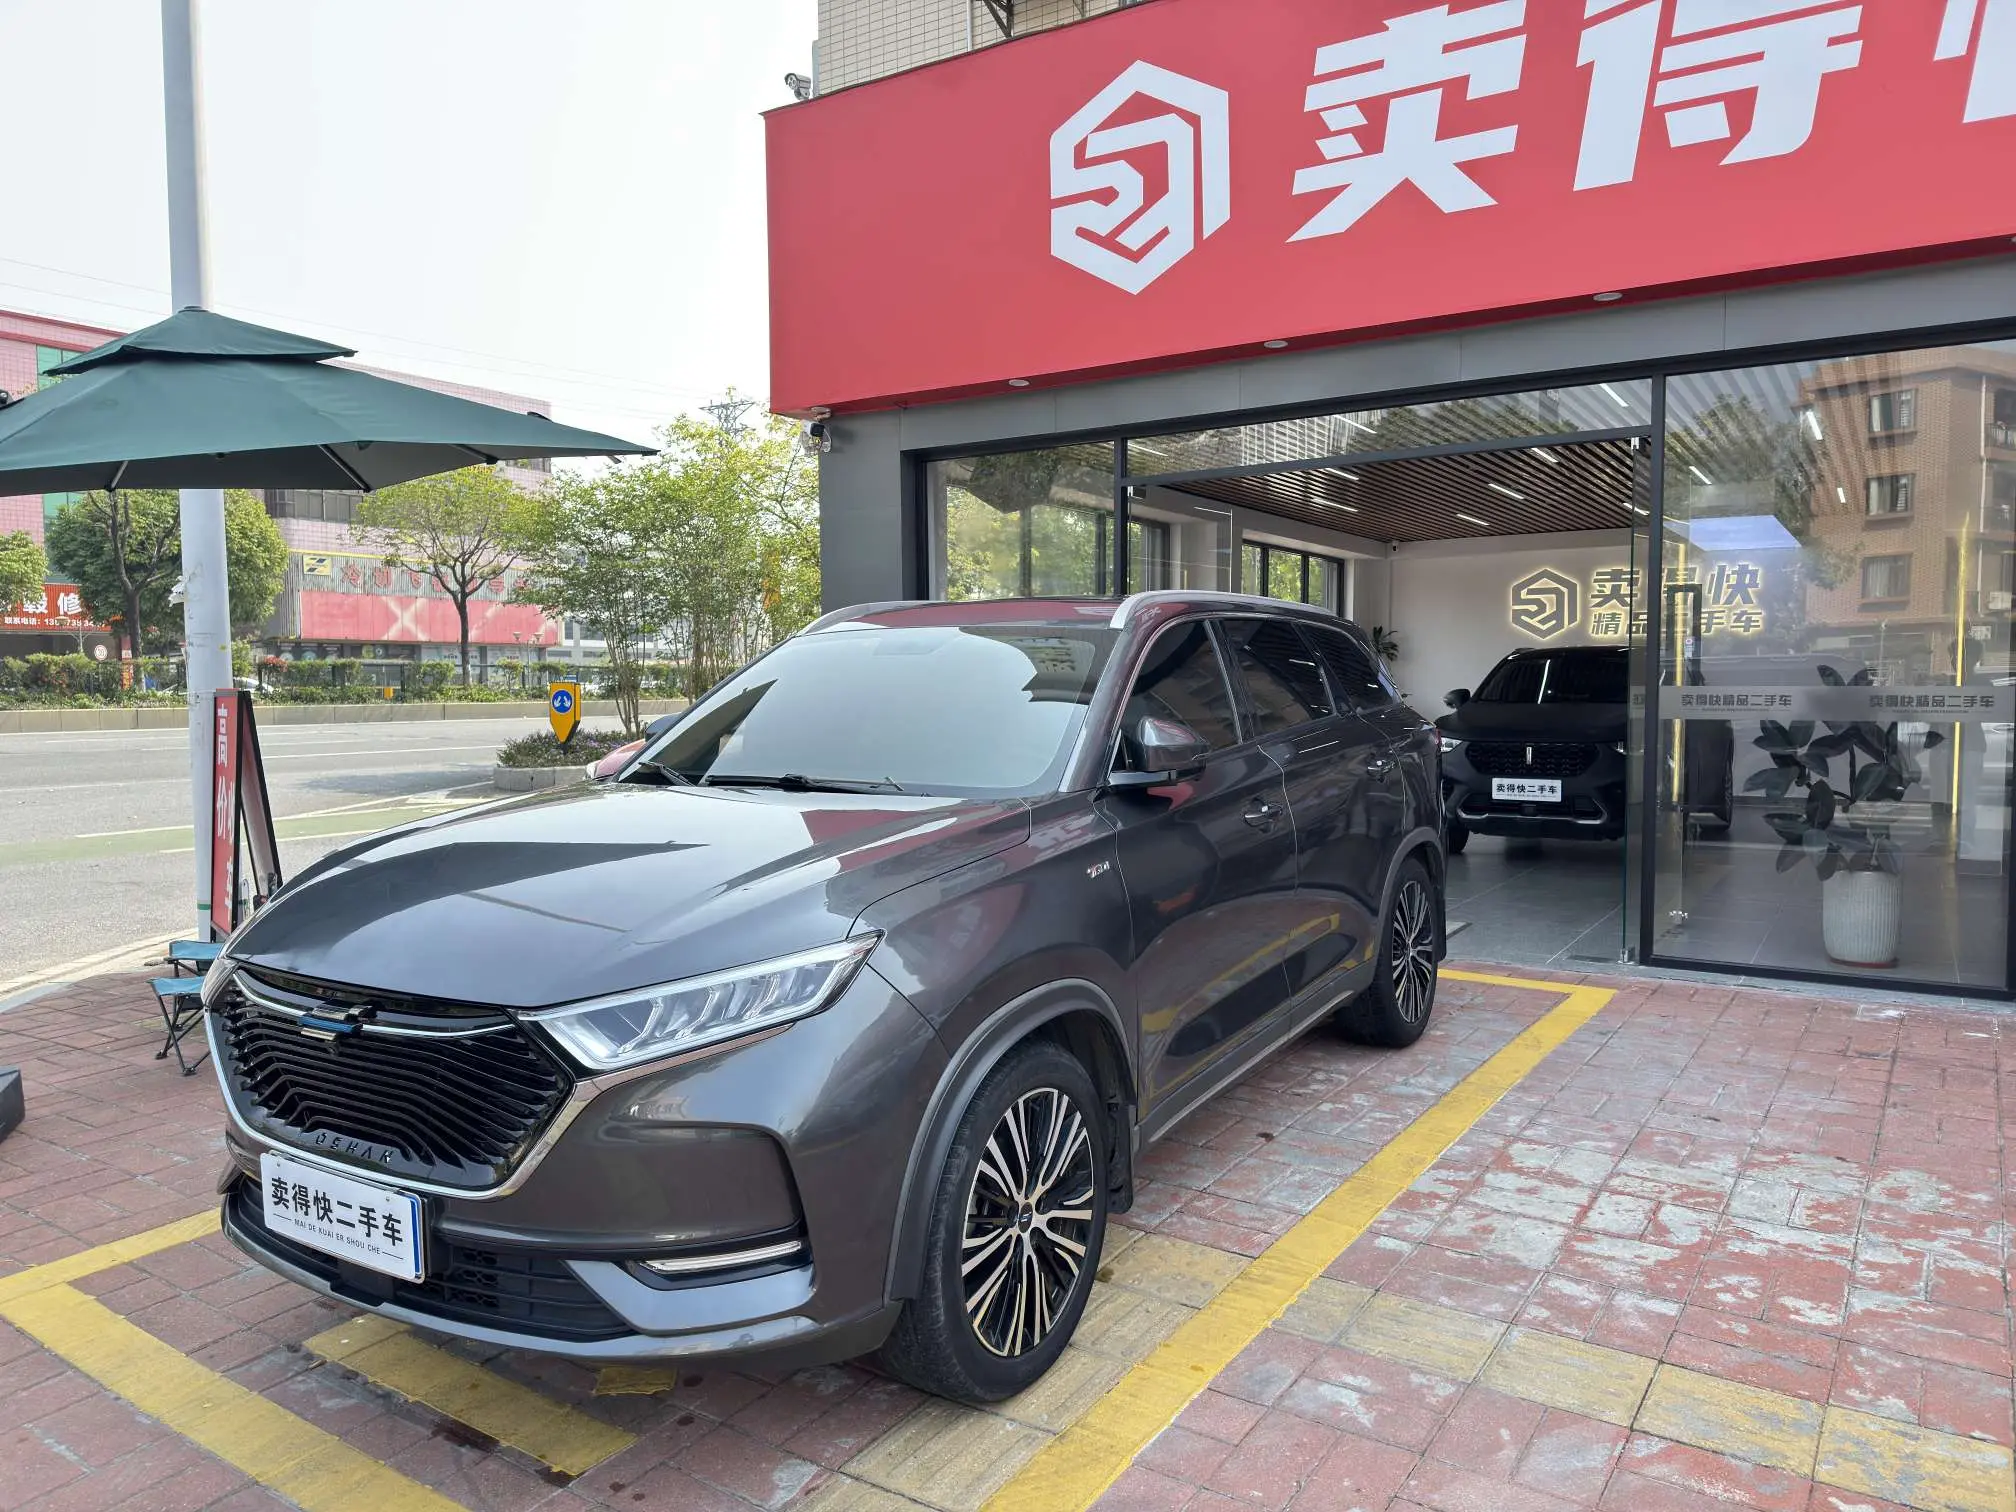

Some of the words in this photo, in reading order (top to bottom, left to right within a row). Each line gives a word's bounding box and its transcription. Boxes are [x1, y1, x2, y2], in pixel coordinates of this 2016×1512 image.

[1681, 694, 1792, 707] 卖得快精品二手车
[1869, 694, 1995, 708] 卖得快精品二手车
[1496, 783, 1558, 795] 卖得快二手车
[315, 1132, 394, 1163] OSHAN
[271, 1176, 403, 1247] 卖得快二手车
[294, 1218, 307, 1229] MAI
[308, 1224, 317, 1233] DE
[318, 1226, 334, 1240] KUAI
[336, 1231, 344, 1241] ER
[346, 1236, 365, 1249] SHOU
[367, 1244, 381, 1255] CHE
